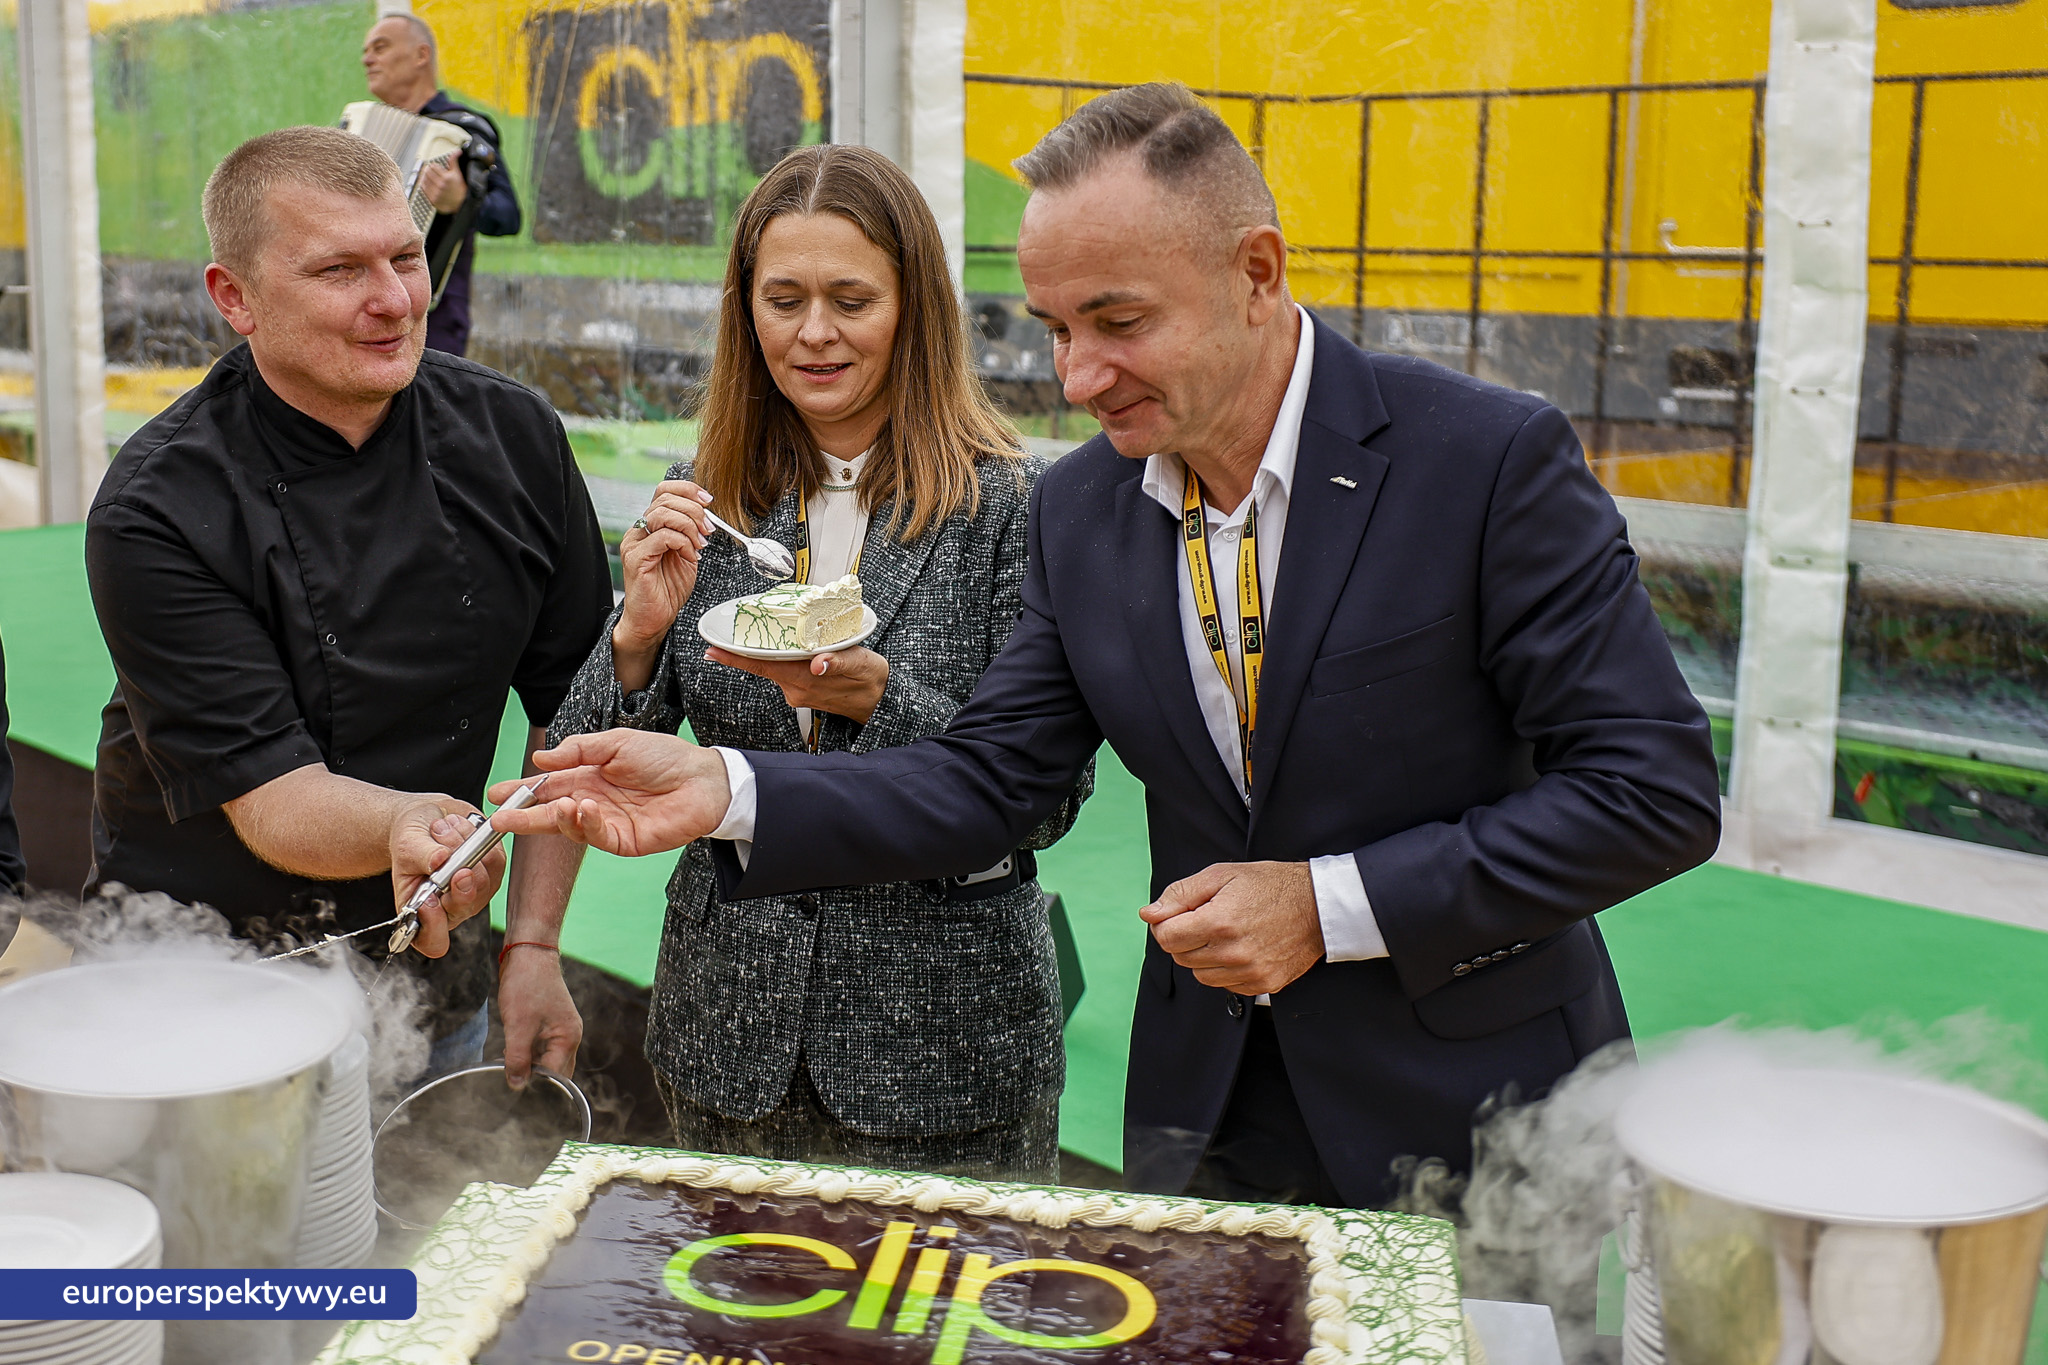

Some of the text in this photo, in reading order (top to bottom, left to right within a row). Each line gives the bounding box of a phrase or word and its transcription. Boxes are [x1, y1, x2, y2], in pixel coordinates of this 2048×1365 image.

[576, 1, 824, 243] clip
[1185, 513, 1201, 534] clip
[1205, 620, 1219, 646] clip
[1243, 622, 1261, 649] clip
[661, 1221, 1158, 1365] clip
